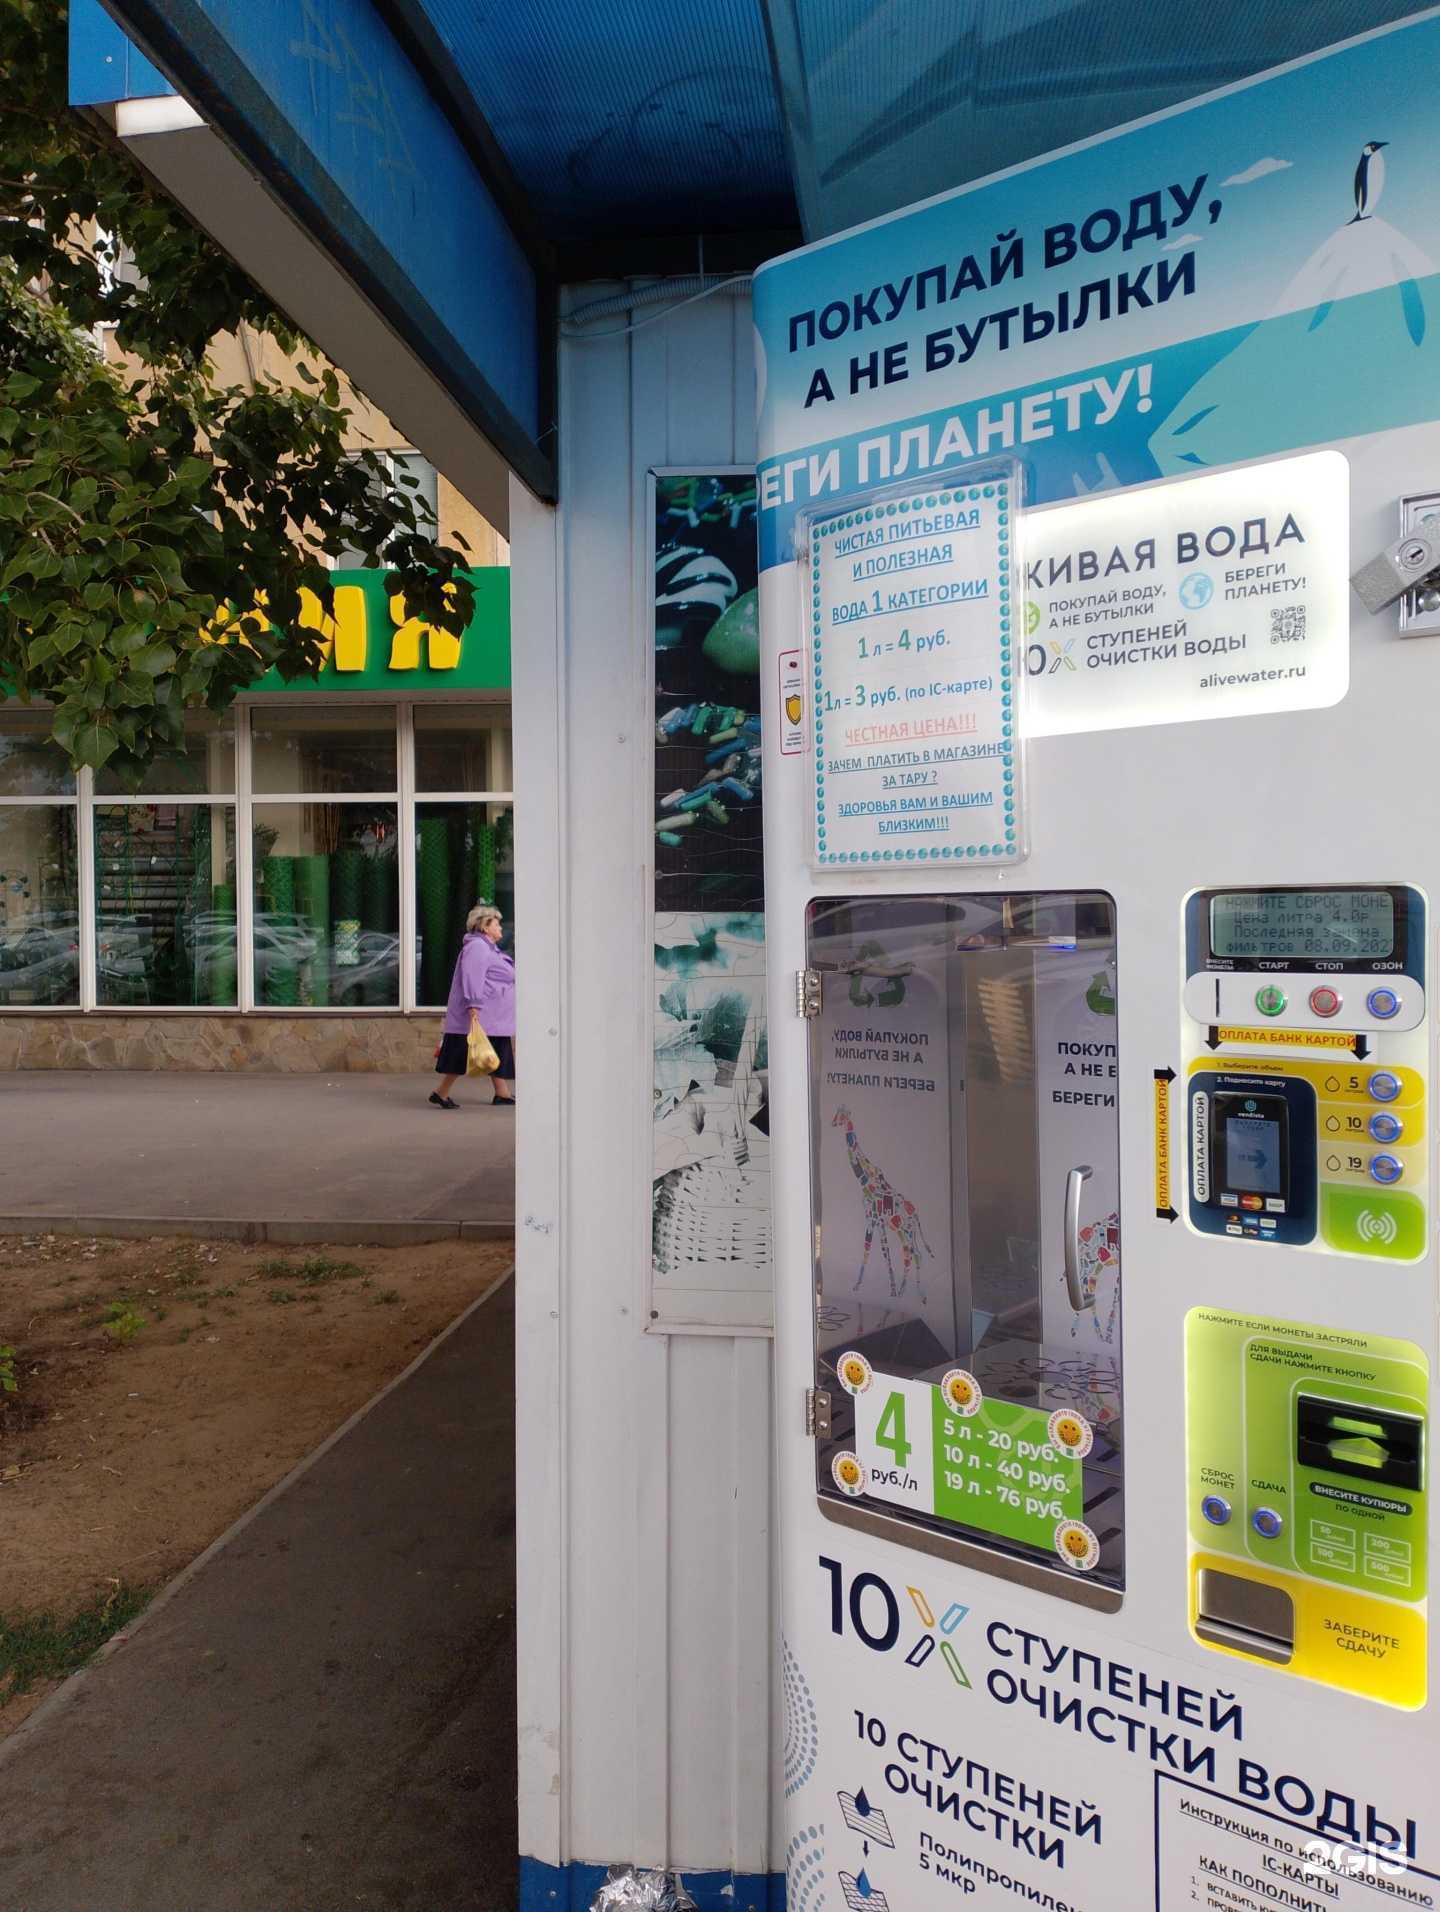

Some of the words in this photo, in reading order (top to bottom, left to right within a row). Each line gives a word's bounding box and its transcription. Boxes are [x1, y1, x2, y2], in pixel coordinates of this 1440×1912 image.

[788, 231, 1025, 353] ПОКУПАЙ
[1043, 173, 1225, 269] ВОДУ,
[803, 368, 836, 409] А
[849, 342, 909, 395] НЕ
[925, 250, 1197, 373] БУТЫЛКИ
[858, 363, 1153, 484] ПЛАНЕТУ!
[834, 527, 884, 555] ЧИСТАЯ
[888, 508, 980, 540] ПИТЬЕВАЯ
[1176, 512, 1306, 565] ВОДА
[853, 562, 862, 578] И
[866, 544, 953, 575] ПОЛЕЗНАЯ
[1224, 562, 1287, 584] БЕРЕГИ
[832, 600, 868, 622] ВОДА
[872, 589, 884, 613] 1
[888, 578, 989, 610] КАТЕГОРИИ
[1049, 590, 1118, 614] ПОКУПАЙ
[1122, 583, 1167, 604] ВОДУ,
[1224, 576, 1307, 601] ПЛАНЕТУ!
[1048, 616, 1060, 629] А
[1063, 613, 1083, 628] НЕ
[1084, 602, 1154, 624] БУТЫЛКИ
[858, 637, 869, 659] 1
[898, 629, 911, 651] 4
[916, 629, 951, 653] руб.
[1086, 621, 1188, 650] СТУПЕНЕЙ
[1086, 642, 1178, 670] ОЧИСТКИ
[1185, 633, 1247, 661] ВОДЫ
[855, 684, 867, 706] 3
[870, 685, 901, 708] руб.
[905, 685, 926, 702] (по
[928, 675, 993, 698] IC-карте)
[1200, 665, 1306, 689] alivewater.ru
[845, 724, 910, 745] ЧЕСТНАЯ
[914, 712, 977, 737] ЦЕНА!!!
[828, 757, 862, 772] ЗАЧЕМ
[867, 751, 920, 767] ПЛАТИТЬ
[923, 750, 931, 762] В
[934, 742, 1005, 761] МАГАЗИНЕ
[882, 774, 897, 787] ЗА
[900, 772, 928, 786] ТАРУ
[838, 799, 897, 815] ЗДОРОВЬЯ
[901, 796, 927, 809] ВАМ
[930, 795, 939, 807] И
[942, 791, 993, 806] ВАШИМ
[878, 815, 950, 833] БЛИЗКИМ!!!
[1295, 895, 1342, 909] СБРОС
[1234, 911, 1270, 925] Цена
[1277, 913, 1324, 924] литра
[1234, 925, 1315, 939] Последняя
[1304, 939, 1392, 954] 08.09.202
[1258, 961, 1290, 970] СТАРТ
[1315, 962, 1344, 971] СТОП
[1372, 962, 1404, 971] ОЗОН
[1219, 1030, 1266, 1042] ОПЛАТА
[1270, 1033, 1303, 1046] БАНК
[1306, 1034, 1357, 1048] КАРТОЙ
[1064, 1062, 1076, 1075] А
[1081, 1063, 1103, 1077] НЕ
[1349, 1076, 1359, 1089] 5
[1052, 1090, 1115, 1107] БЕРЕГИ
[1158, 1080, 1168, 1124] КАРТОЙ
[1195, 1097, 1205, 1145] КАРТОЙ
[1346, 1116, 1362, 1129] 10
[1159, 1126, 1168, 1158] БАНК
[1197, 1147, 1206, 1196] ОПЛАТА
[1348, 1156, 1362, 1169] 19
[1159, 1162, 1168, 1207] ОПЛАТА
[1198, 1313, 1244, 1327] НАЖМИТЕ
[1246, 1321, 1271, 1332] ЕСЛИ
[1272, 1327, 1314, 1339] МОНЕТЫ
[1317, 1333, 1368, 1348] ЗАСТРЯЛИ
[1250, 1343, 1270, 1354] ДЛЯ
[1272, 1347, 1313, 1361] ВЫДАЧИ
[1250, 1353, 1282, 1366] СДАЧИ
[1284, 1360, 1334, 1374] НАЖМИТЕ
[1335, 1367, 1377, 1381] КНОПКУ
[875, 1391, 912, 1469] 4
[943, 1418, 954, 1436] 5
[958, 1427, 971, 1441] л
[988, 1431, 1012, 1451] 20
[1017, 1440, 1059, 1463] руб.
[871, 1466, 919, 1492] руб./л
[943, 1444, 964, 1464] 10
[967, 1454, 980, 1469] л
[996, 1460, 1023, 1481] 40
[1028, 1469, 1071, 1494] руб.
[1201, 1467, 1235, 1481] СБРОС
[1201, 1476, 1235, 1489] МОНЕТ
[944, 1470, 963, 1490] 19
[967, 1481, 980, 1496] л
[996, 1485, 1020, 1508] 76
[1026, 1496, 1068, 1521] руб.
[1251, 1479, 1287, 1494] СДАЧА
[1314, 1485, 1360, 1502] ВНЕСИТЕ
[1361, 1496, 1407, 1513] КУПЮРЫ
[1323, 1618, 1400, 1650] ЗАБЕРИТЕ
[1336, 1637, 1386, 1660] СДАЧУ
[986, 1620, 1244, 1742] СТУПЕНЕЙ
[854, 1709, 887, 1748] 10
[896, 1732, 1102, 1846] СТУПЕНЕЙ
[986, 1667, 1216, 1782] ОЧИСТКИ
[1239, 1757, 1417, 1859] ВОДЫ
[884, 1763, 1066, 1869] ОЧИСТКИ
[1180, 1798, 1270, 1845] Инструкция
[1274, 1836, 1294, 1853] по
[919, 1852, 930, 1871] 5
[936, 1867, 976, 1895] мкр
[1199, 1855, 1228, 1877] КАК
[1262, 1854, 1340, 1897] IC-КАРТЫ
[1207, 1882, 1257, 1911] ВСТАВИТЬ
